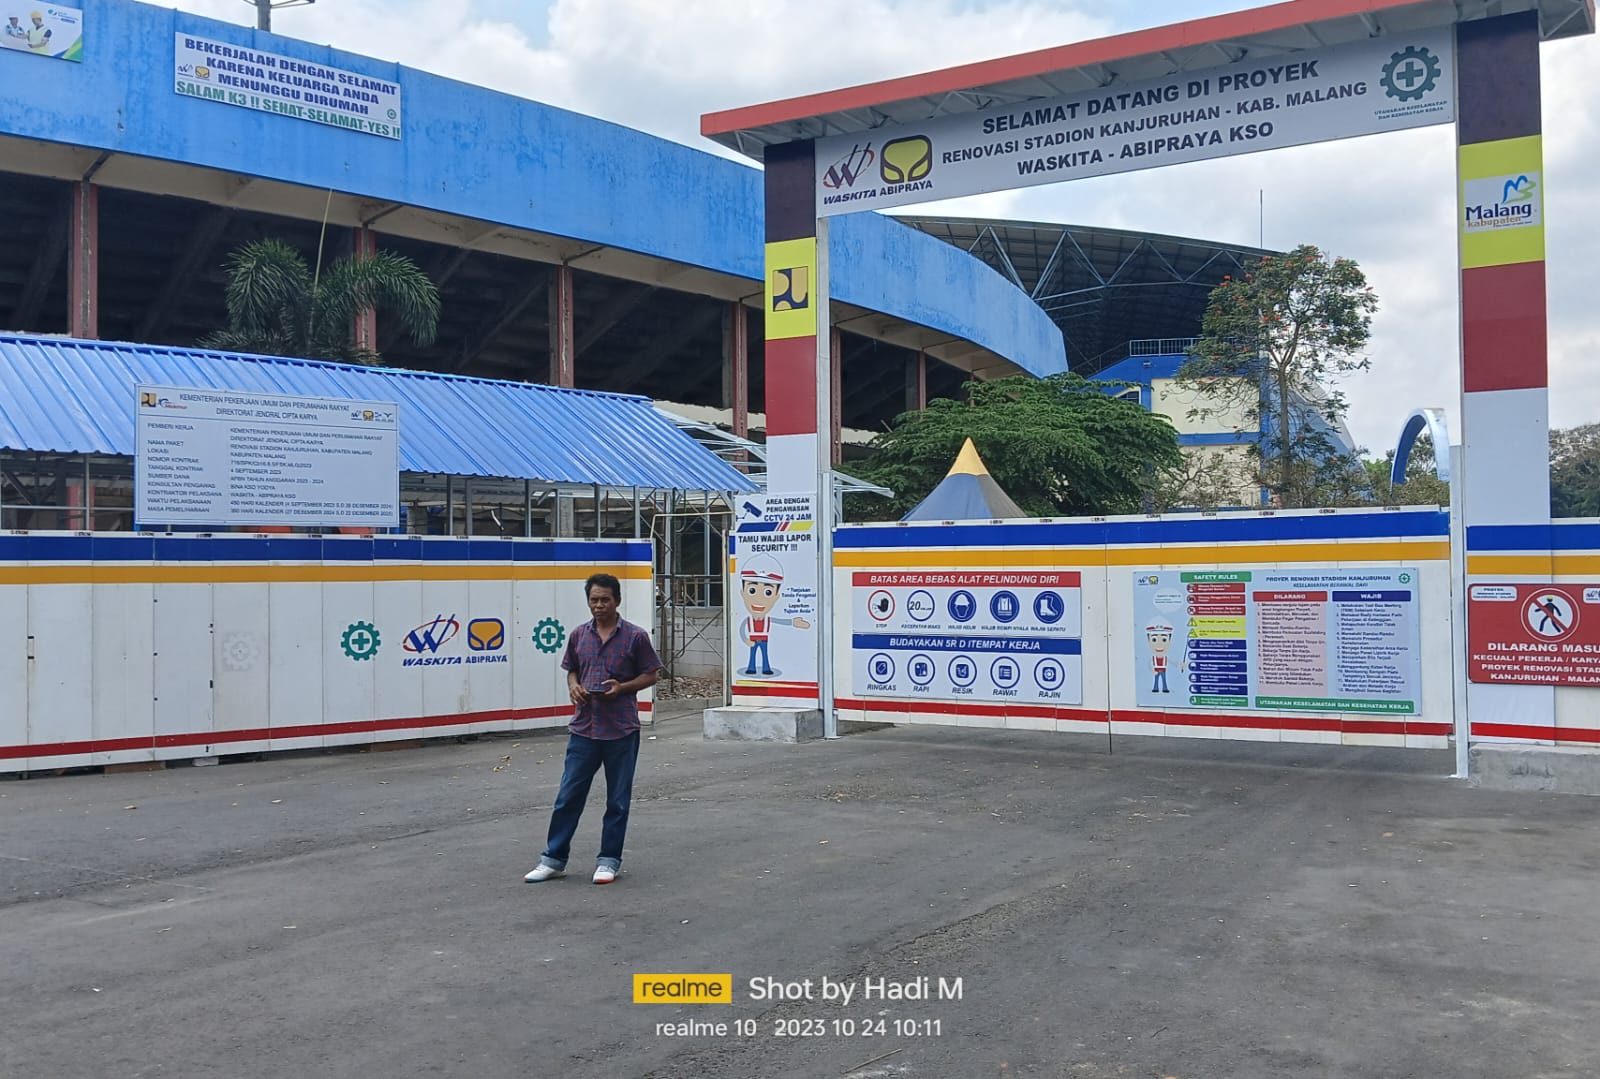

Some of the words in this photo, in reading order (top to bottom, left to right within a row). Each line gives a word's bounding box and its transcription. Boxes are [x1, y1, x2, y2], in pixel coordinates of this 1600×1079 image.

[185, 38, 275, 67] BEKERJALAH
[280, 59, 335, 80] DENGAN
[338, 73, 397, 95] SELAMAT
[206, 57, 264, 78] KARENA
[268, 70, 340, 95] KELUARGA
[343, 87, 379, 104] ANDA
[177, 80, 225, 100] SALAM
[229, 90, 246, 105] K3
[218, 73, 300, 99] MENUNGGU
[304, 92, 369, 115] DIRUMAH
[982, 102, 1081, 134] SELAMAT
[1087, 85, 1180, 116] DATANG
[1187, 79, 1210, 98] DI
[1218, 60, 1319, 93] PROYEK
[942, 140, 1019, 164] RENOVASI
[1024, 127, 1094, 150] STADION
[1100, 105, 1220, 138] KANJURUHAN
[1236, 97, 1280, 115] KAB.
[1286, 81, 1367, 107] MALANG
[1017, 149, 1103, 175] WASKITA
[1119, 129, 1223, 159] ABIPRAYA
[1229, 122, 1274, 142] KSO
[823, 189, 877, 205] WASKITA
[879, 180, 933, 197] ABIPRAYA
[1465, 203, 1532, 221] Malang
[1468, 216, 1521, 229] kabupaten
[180, 394, 223, 403] KEMENTERIAN
[224, 397, 260, 406] PEKERJAAN
[261, 399, 278, 407] UMUM
[292, 402, 328, 410] PERUMAHAN
[329, 404, 350, 412] RAKYAT
[216, 408, 253, 416] DIREKTORAT
[282, 412, 298, 420] CIPTA
[299, 413, 318, 421] KARYA
[783, 497, 810, 505] DENGAN
[796, 513, 812, 521] JAM
[738, 535, 760, 543] TAMU
[760, 534, 785, 543] WAJIB
[786, 534, 812, 542] LAPOR
[751, 544, 789, 552] SECURITY
[870, 575, 898, 584] BATAS
[899, 575, 924, 584] AREA
[925, 575, 956, 584] BEBAS
[957, 575, 981, 584] ALAT
[983, 575, 1037, 584] PELINDUNG
[1039, 575, 1060, 584] DIRI
[909, 601, 921, 610] 20
[889, 638, 944, 648] BUDAYAKAN
[945, 639, 957, 648] 5R
[1008, 640, 1041, 650] KERJA
[1488, 643, 1558, 652] DILARANG
[402, 656, 462, 667] WASKITA
[465, 654, 508, 664] ABIPRAYA
[1518, 655, 1563, 663] PEKERJA
[1523, 665, 1573, 673] RENOVASI
[1490, 673, 1559, 682] KANJURUHAN
[867, 684, 897, 692] RINGKAS
[913, 685, 930, 693] RAPI
[952, 687, 974, 695] RESIK
[992, 688, 1018, 697] RAWAT
[1038, 690, 1061, 699] RAJIN
